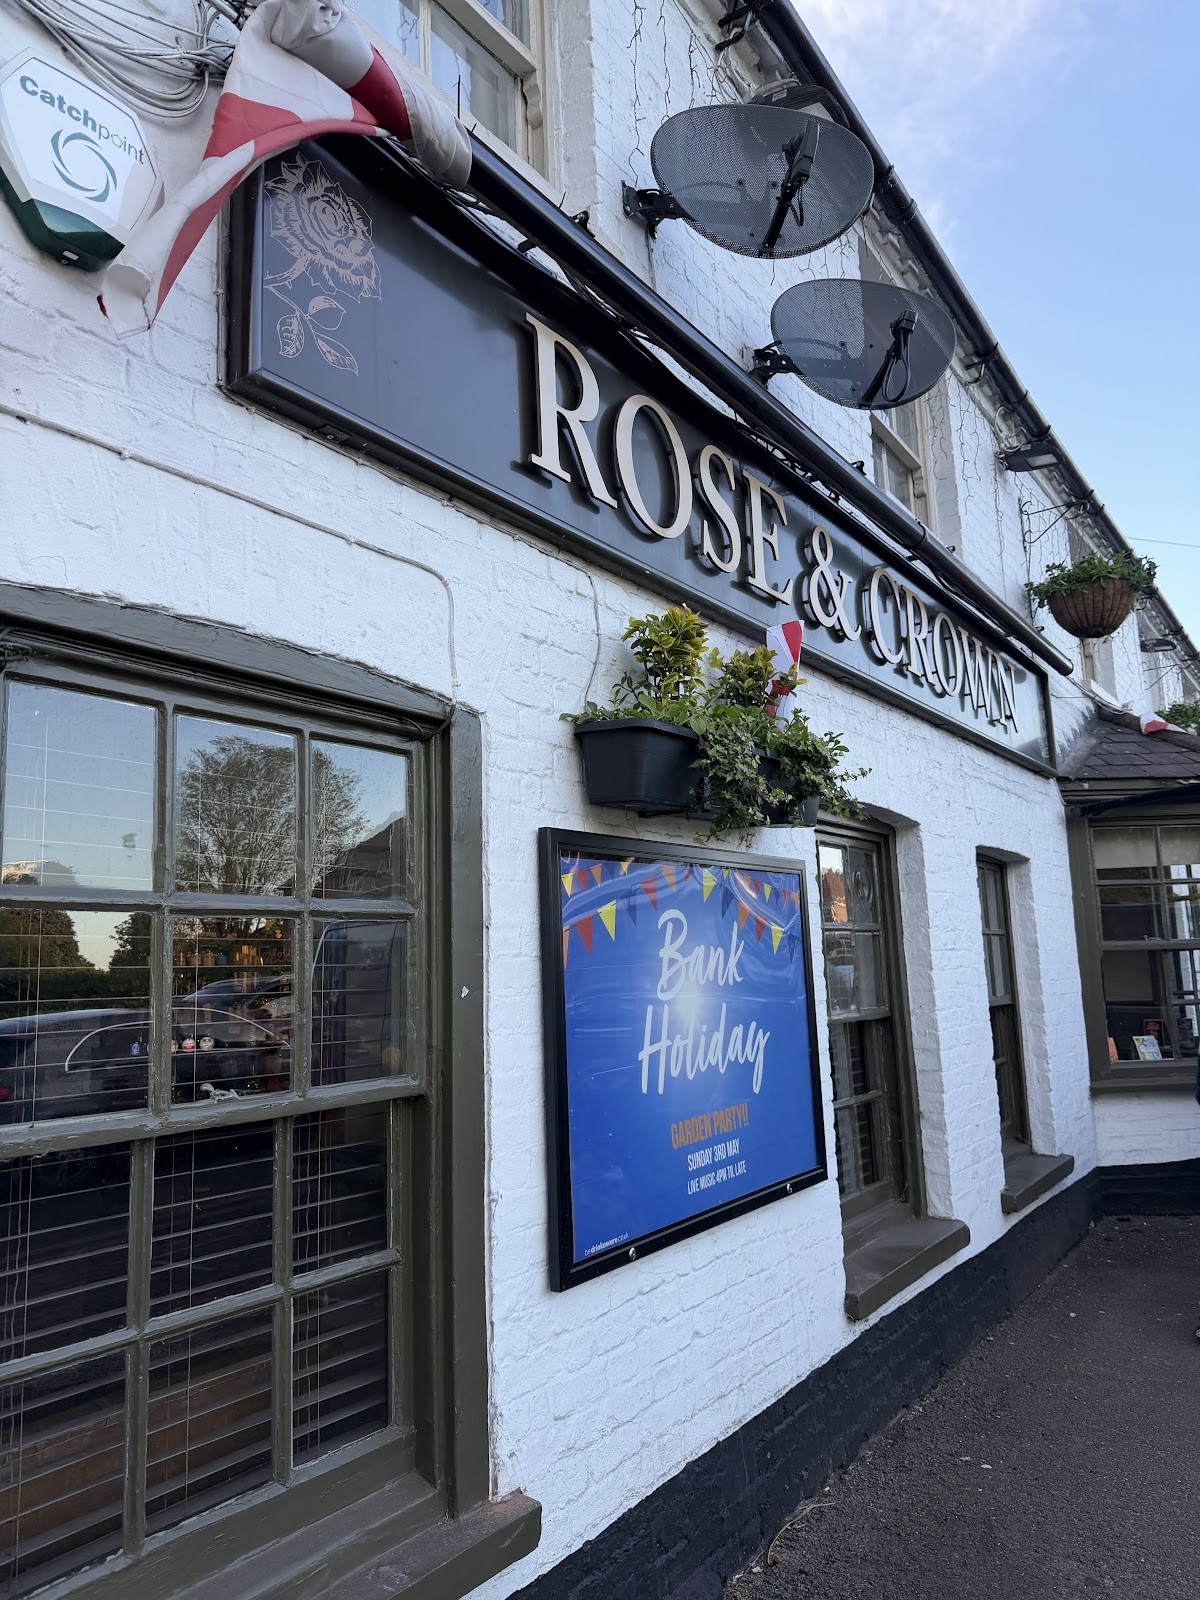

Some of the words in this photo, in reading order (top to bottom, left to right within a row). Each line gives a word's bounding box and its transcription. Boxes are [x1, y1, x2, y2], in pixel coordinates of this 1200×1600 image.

[19, 75, 145, 165] Catchpoint
[525, 312, 793, 606] ROSE
[808, 525, 862, 642] &
[869, 567, 1019, 733] CROWN
[656, 908, 745, 1001] Bank
[638, 1001, 771, 1095] Holiday
[671, 1113, 712, 1150] GARDEN
[712, 1103, 749, 1136] PARTY!!
[687, 1147, 713, 1172] SUNDAY
[713, 1142, 727, 1162] 3RD
[726, 1138, 740, 1158] MAY
[687, 1178, 700, 1195] LIVE
[700, 1171, 716, 1191] MUSIC
[716, 1167, 728, 1184] 4PM
[735, 1160, 747, 1176] LATE
